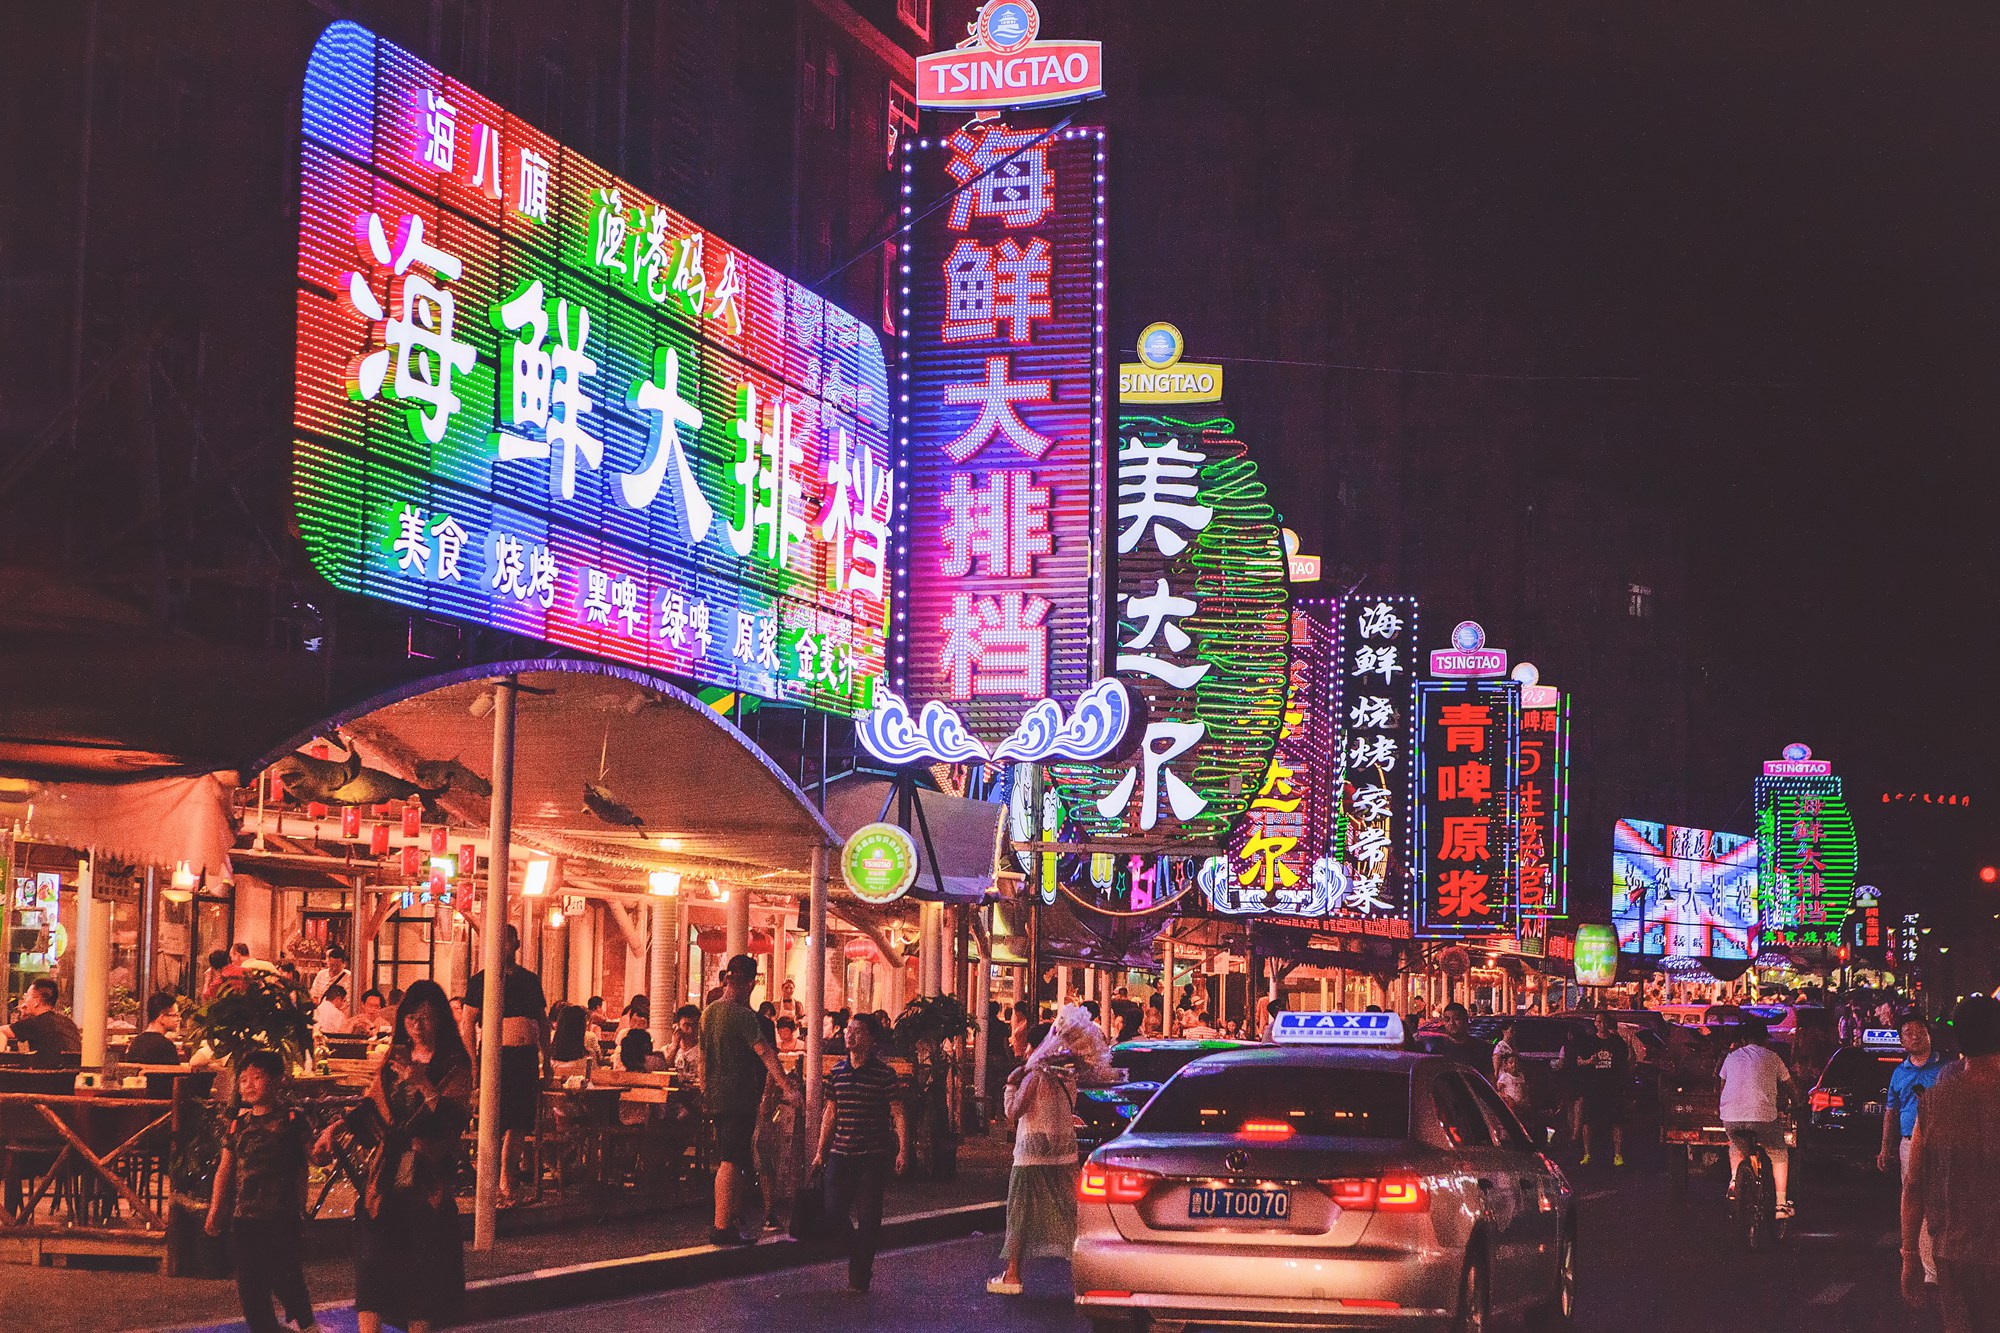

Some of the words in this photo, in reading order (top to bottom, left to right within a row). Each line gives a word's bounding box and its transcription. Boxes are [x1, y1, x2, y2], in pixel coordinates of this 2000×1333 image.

[930, 53, 1088, 93] TSINGTAO
[418, 92, 549, 223] 海八旗
[594, 189, 740, 335] 渔港码头
[348, 213, 894, 600] 海鲜大排档
[941, 127, 1056, 700] 海鲜大排档
[394, 504, 468, 583] 美食
[491, 533, 558, 609] 烧烤
[586, 568, 641, 635] 黑啤
[659, 592, 712, 656] 绿啤
[733, 611, 780, 671] 原浆
[794, 629, 859, 694] 金麦汁
[1436, 655, 1501, 669] TSINGTAO
[1437, 703, 1493, 918] 青啤原浆
[1767, 764, 1827, 773] TSINGTAO
[1792, 794, 1828, 926] 海鲜大排档
[1295, 1015, 1378, 1028] TAXI
